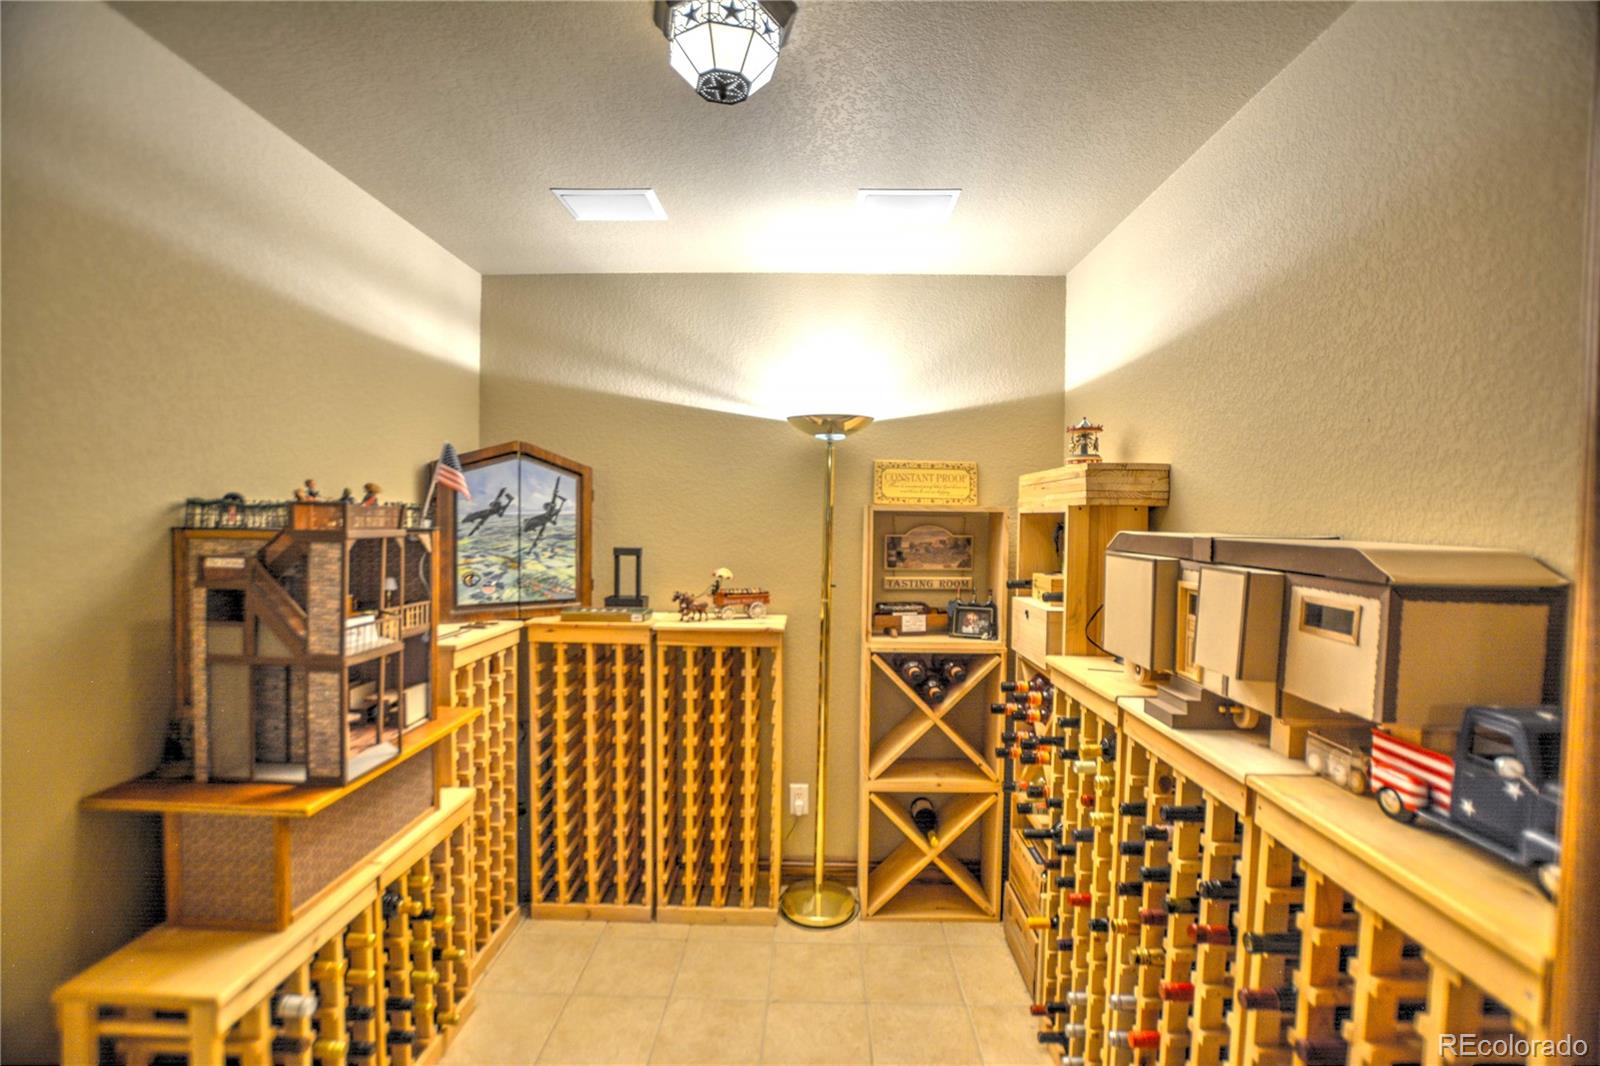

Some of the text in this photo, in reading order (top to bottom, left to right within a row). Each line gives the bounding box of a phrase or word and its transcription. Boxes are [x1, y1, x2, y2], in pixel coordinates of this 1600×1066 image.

[884, 472, 968, 483] CONSTANT PROOF
[886, 579, 970, 588] TASTING ROOM
